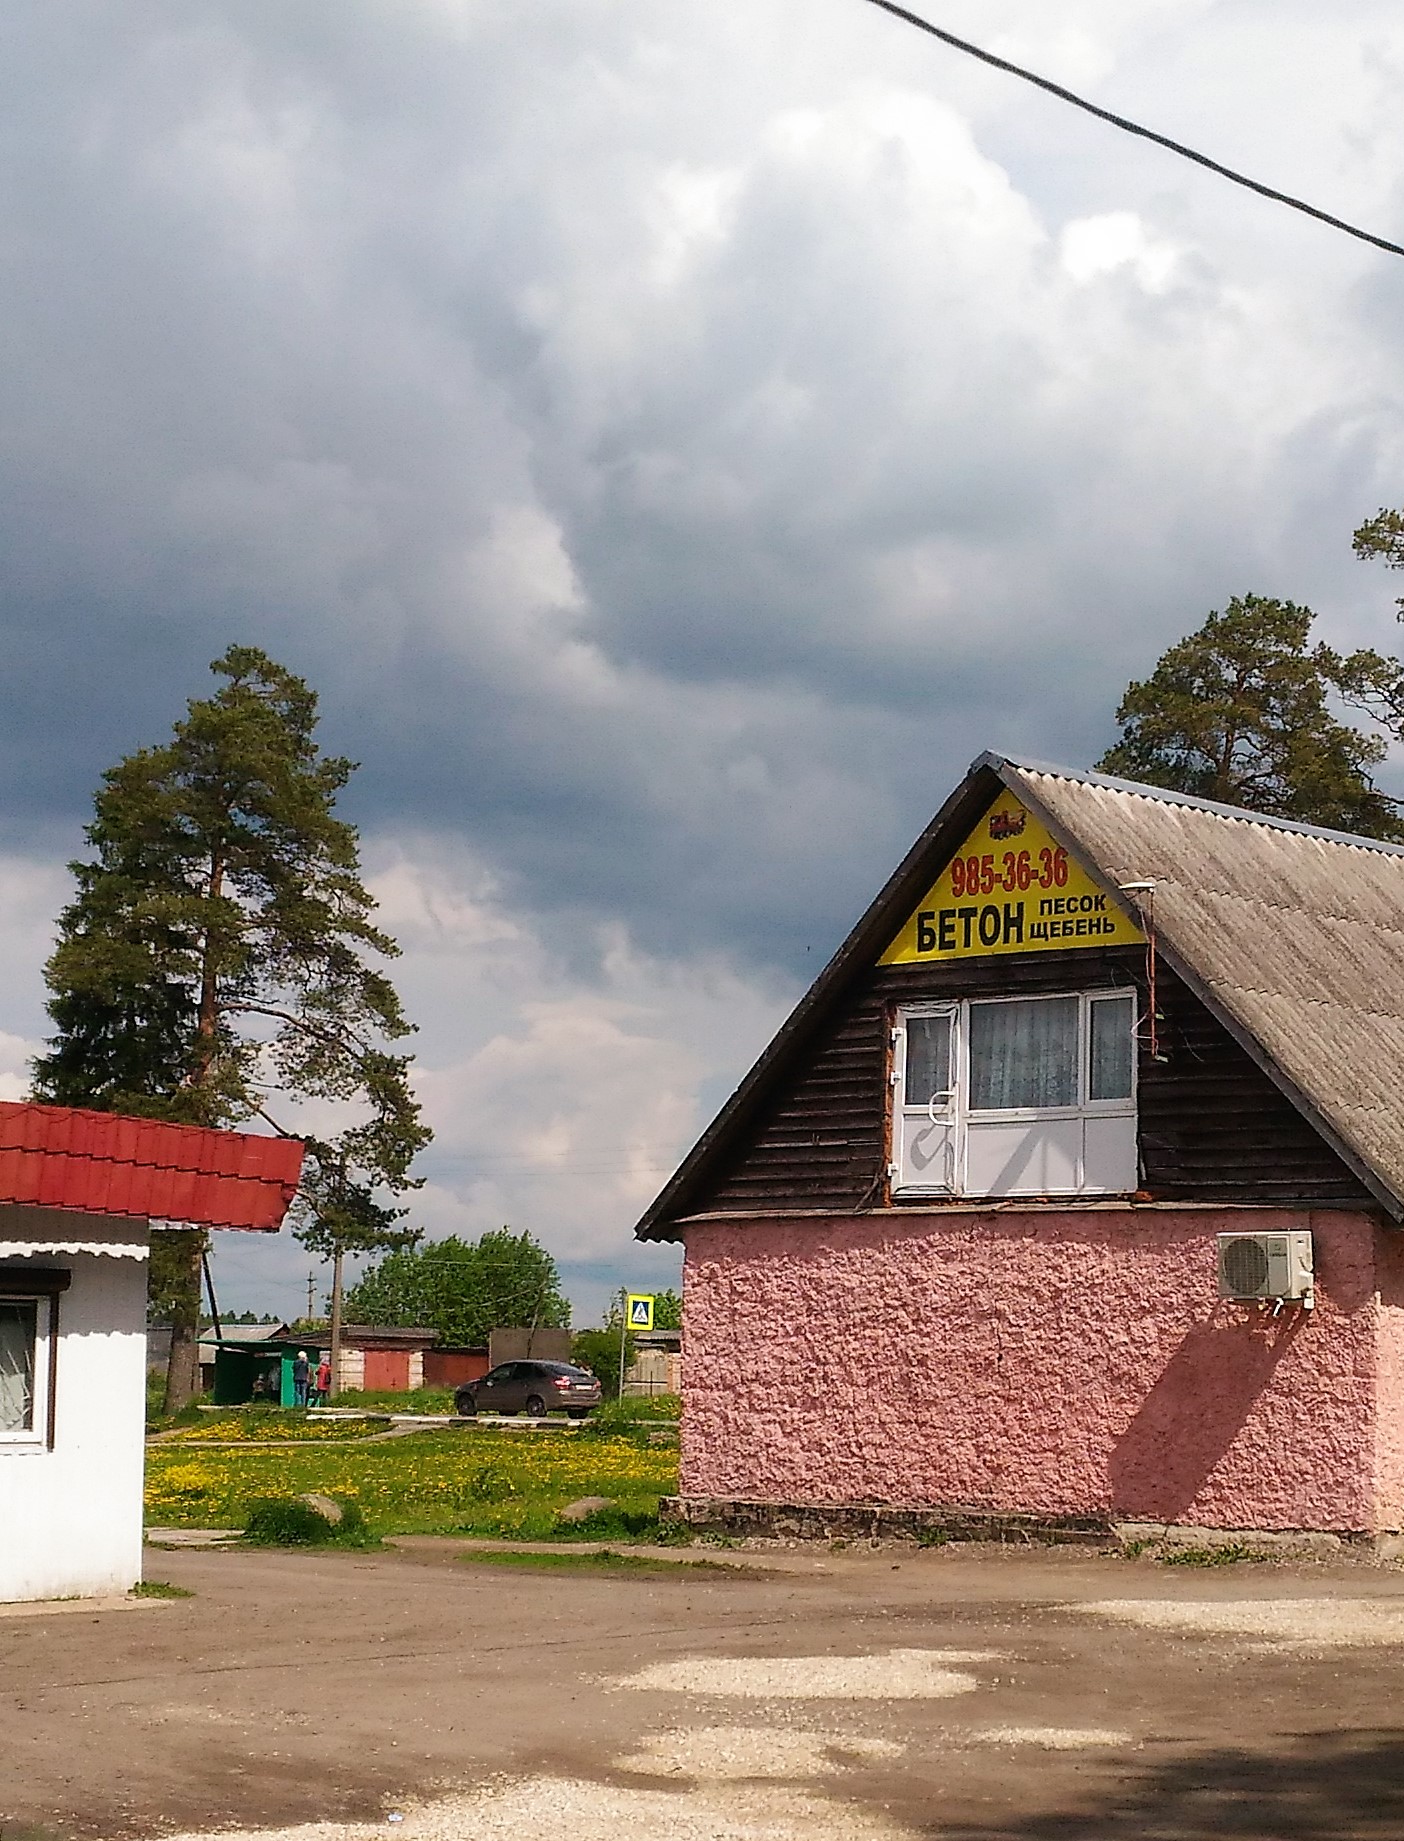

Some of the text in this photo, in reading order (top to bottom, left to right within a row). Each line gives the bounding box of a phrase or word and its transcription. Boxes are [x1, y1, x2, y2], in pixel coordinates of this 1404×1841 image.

[951, 847, 1069, 898] 985-36-36
[1039, 894, 1107, 916] ПЕСОК
[917, 901, 1025, 953] БЕТОН
[1029, 917, 1115, 941] ЩЕБЕНЬ
